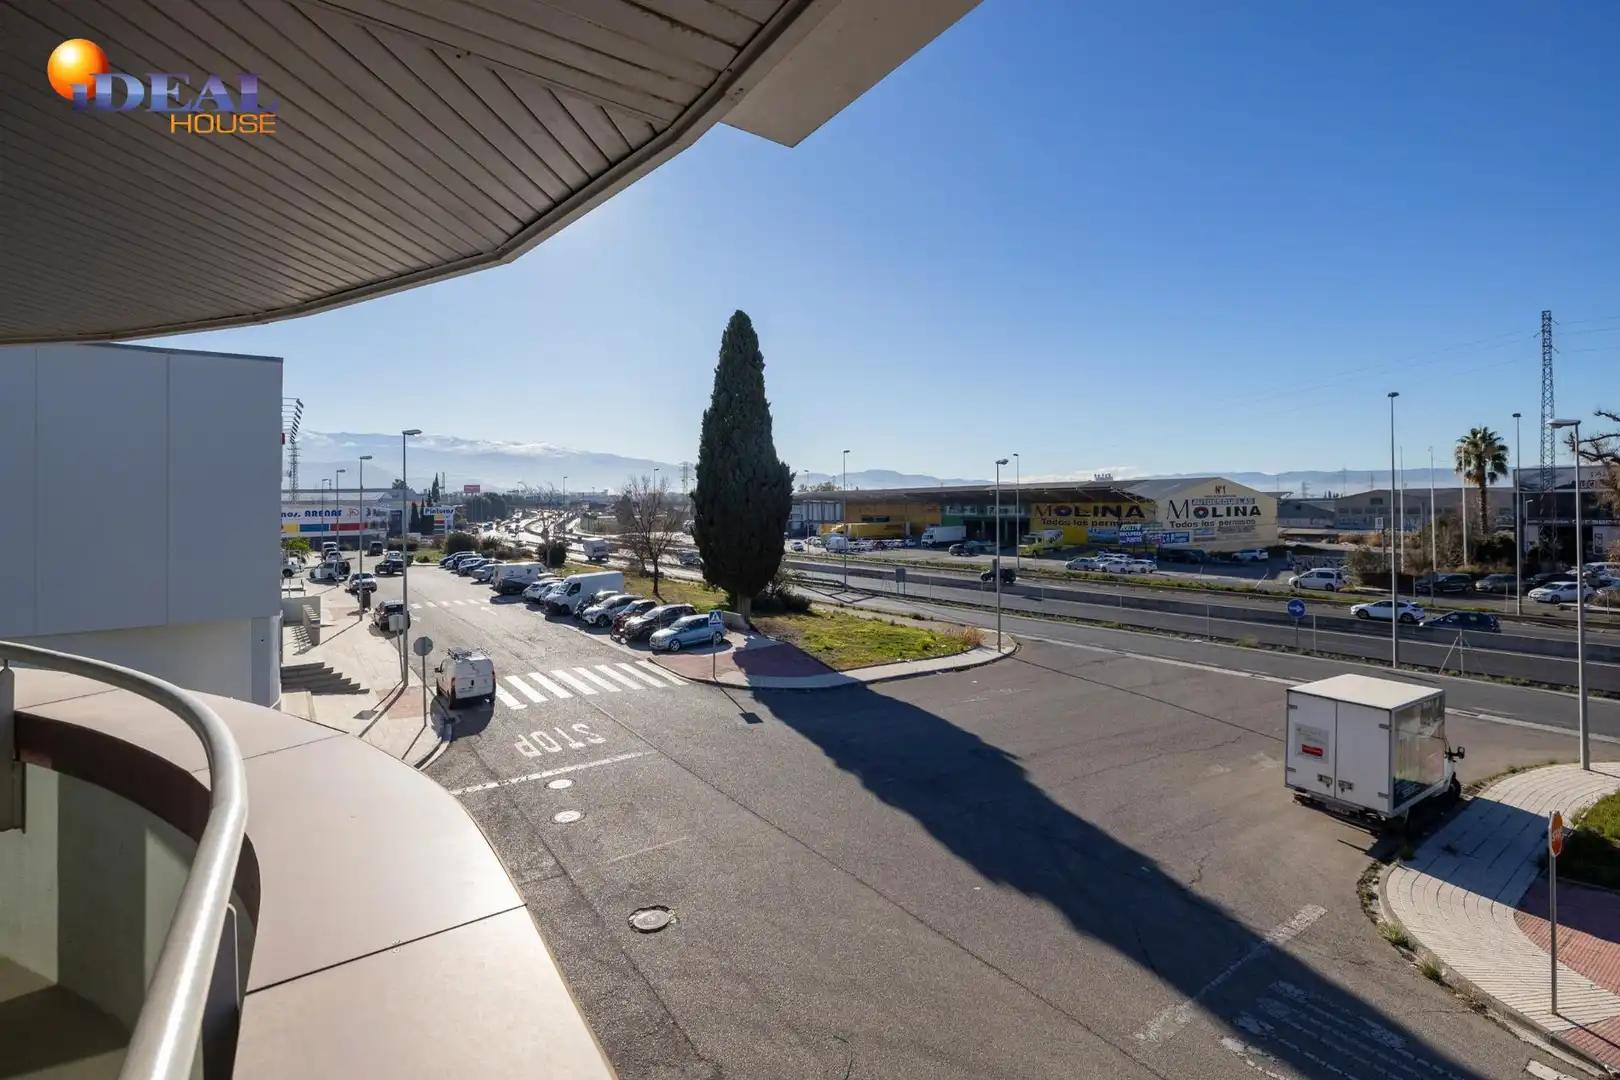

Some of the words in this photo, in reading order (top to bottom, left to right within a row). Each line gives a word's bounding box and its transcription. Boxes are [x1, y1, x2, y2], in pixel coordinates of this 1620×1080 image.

[304, 509, 343, 518] ARENAS
[1033, 504, 1146, 518] MOLINA
[1166, 499, 1262, 520] MOLINA
[1169, 520, 1199, 529] Todos
[1201, 520, 1215, 528] los
[1218, 519, 1256, 528] permisos
[514, 723, 606, 758] STOP
